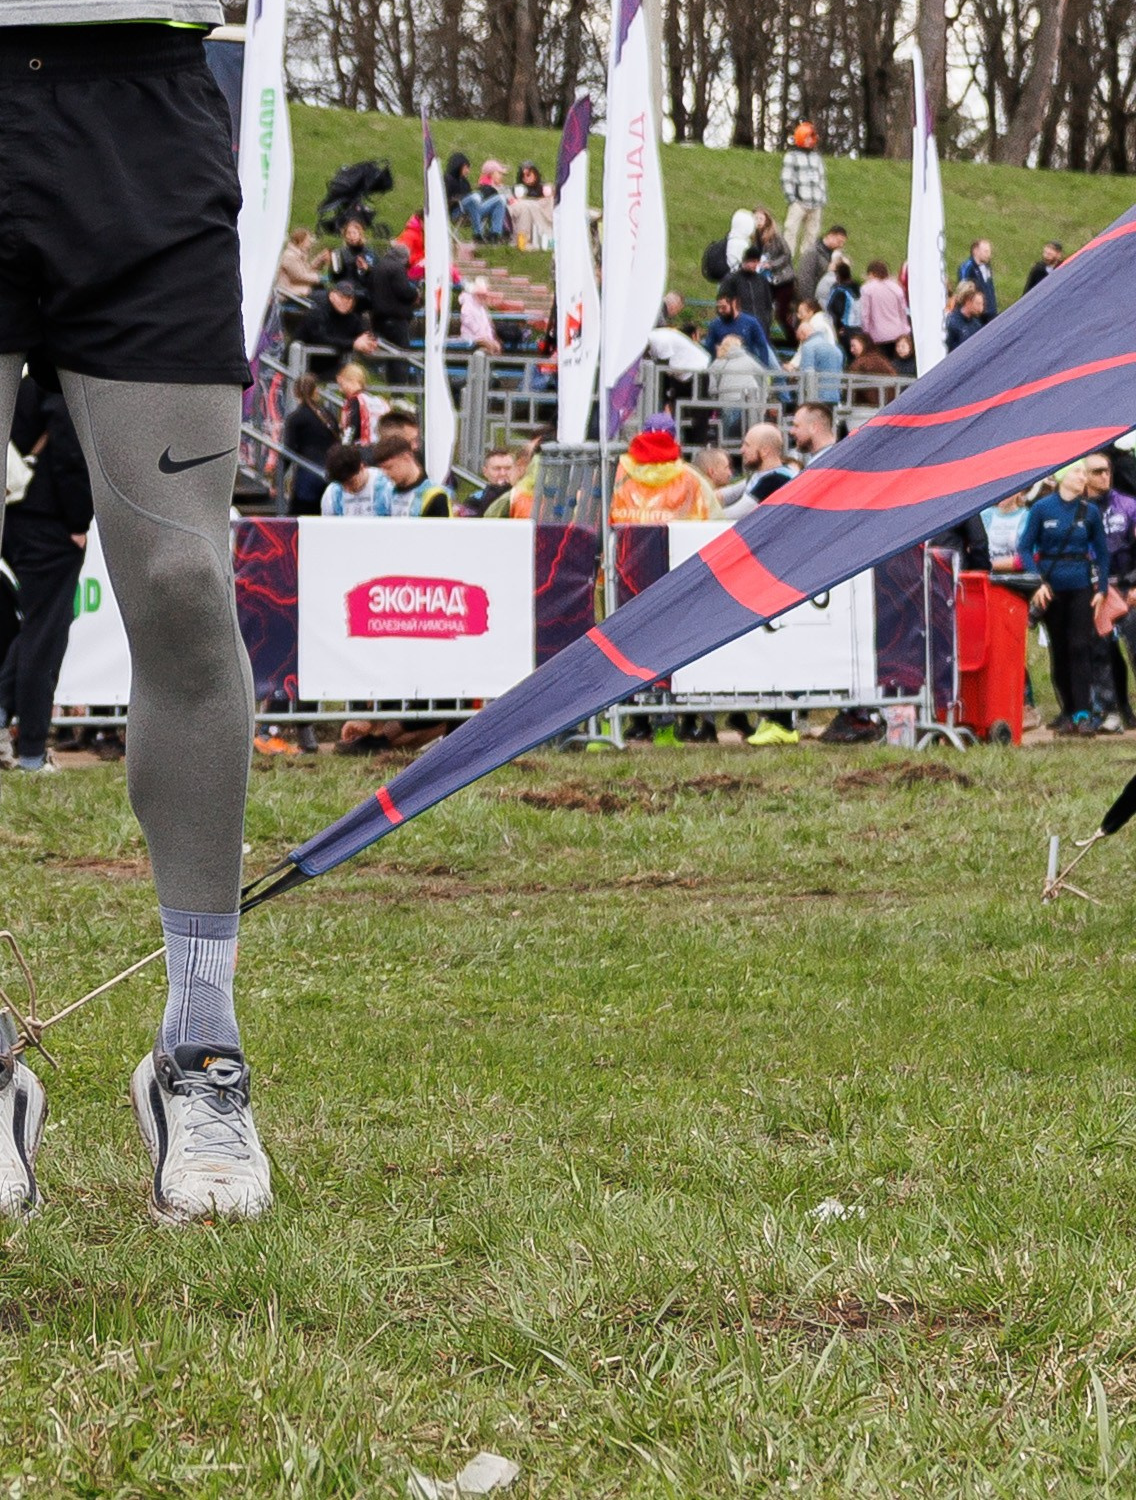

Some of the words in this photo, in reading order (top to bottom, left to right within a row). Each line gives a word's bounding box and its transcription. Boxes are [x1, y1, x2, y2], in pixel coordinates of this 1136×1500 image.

[368, 582, 466, 616] ЭКОНАД
[367, 618, 417, 632] ПОЛЕЗНЫЙ
[418, 618, 465, 632] ЛИМОНАД
